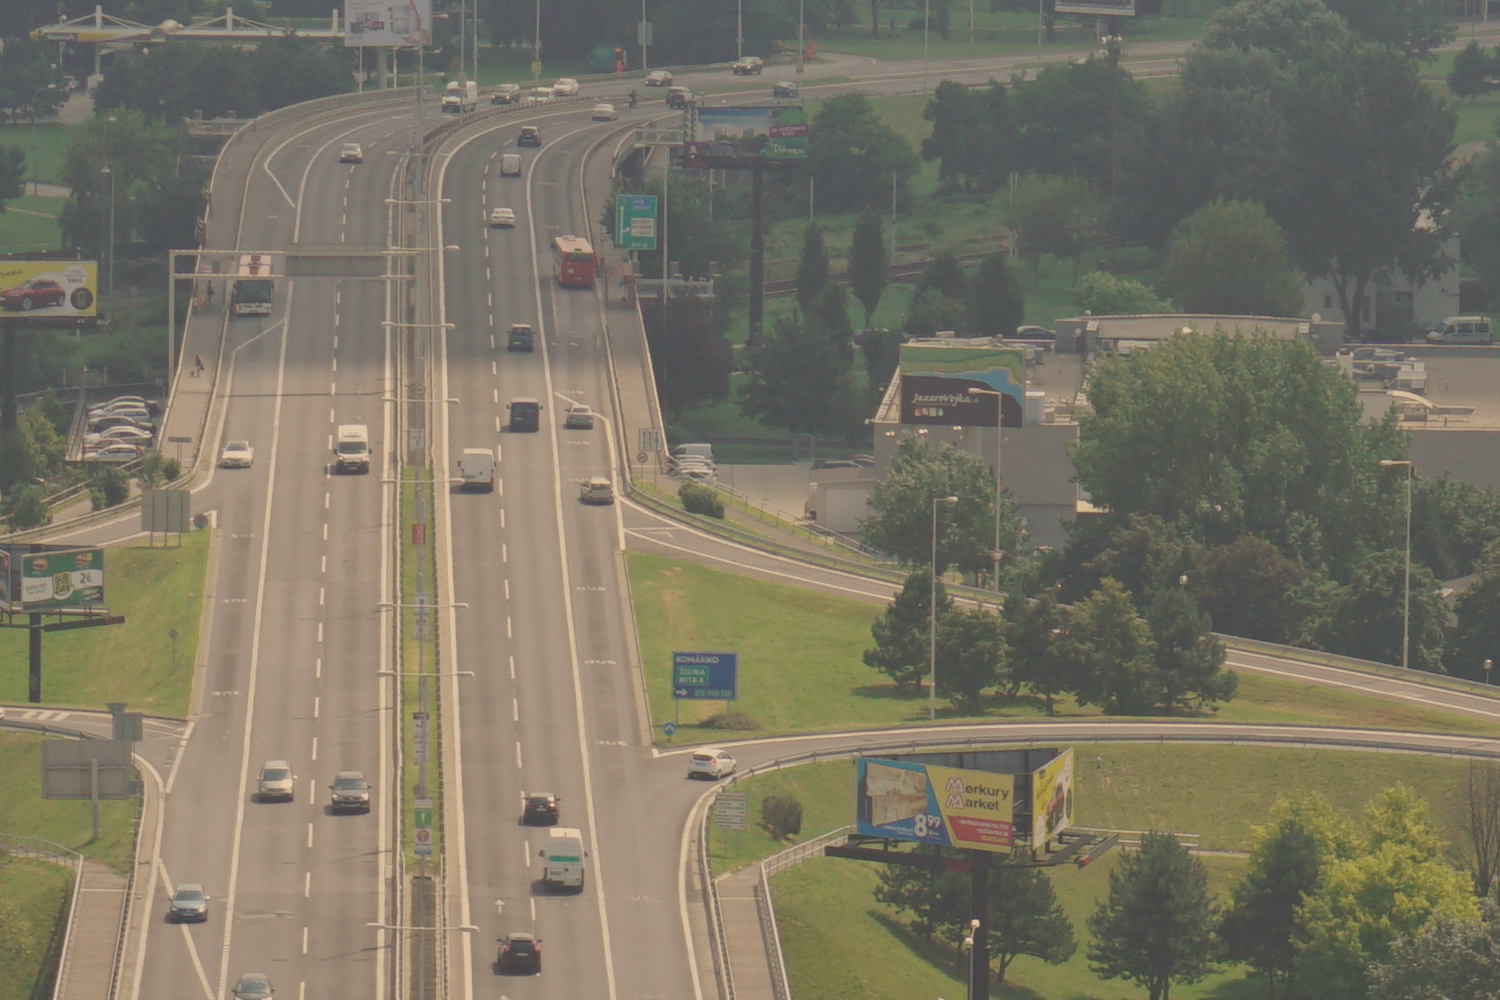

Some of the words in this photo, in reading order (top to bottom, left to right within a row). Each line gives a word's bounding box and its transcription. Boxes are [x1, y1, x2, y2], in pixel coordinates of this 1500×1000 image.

[675, 654, 719, 664] KOMÁRNO
[679, 666, 705, 676] ŽILINA
[945, 777, 1009, 801] Merkury
[945, 793, 1000, 811] Market
